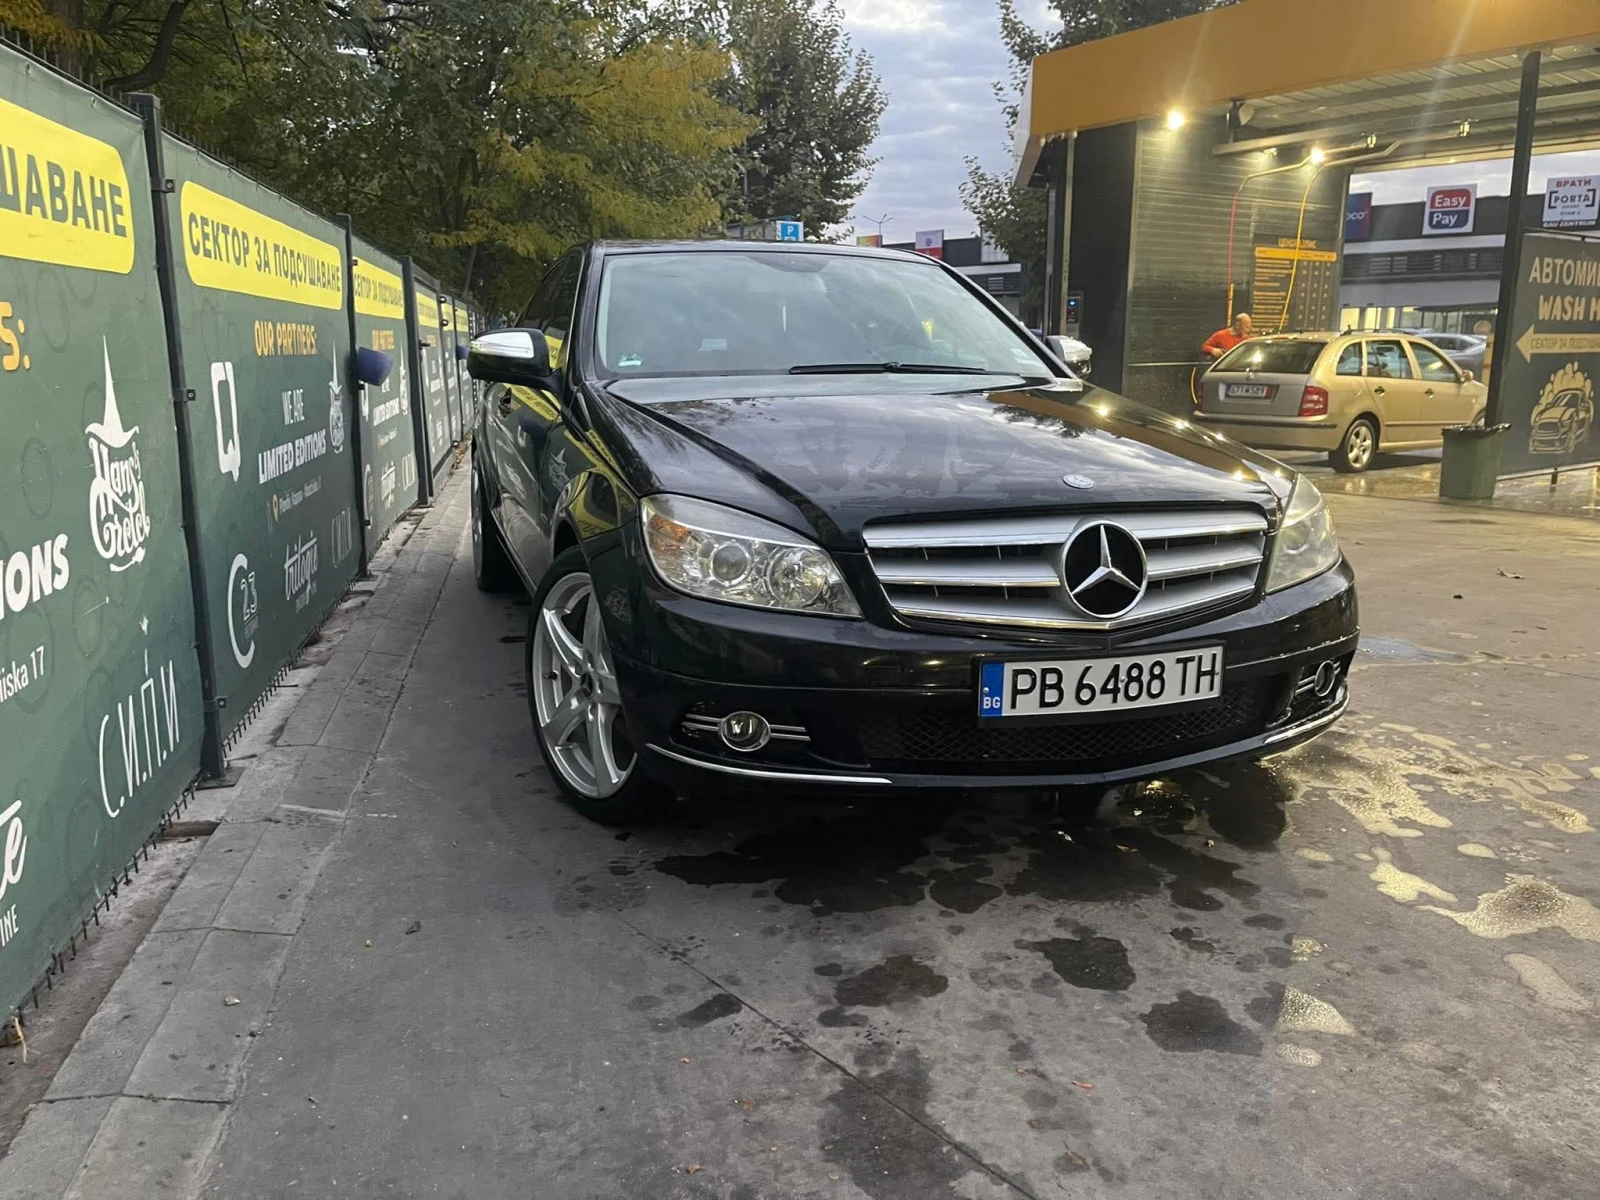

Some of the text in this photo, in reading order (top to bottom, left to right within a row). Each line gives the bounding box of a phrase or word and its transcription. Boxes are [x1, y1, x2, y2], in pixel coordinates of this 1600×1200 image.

[1555, 178, 1592, 188] ВРАТИ
[1434, 194, 1467, 208] Easy
[1554, 194, 1590, 204] PORTA
[787, 225, 794, 236] P
[1432, 212, 1458, 226] Pay
[188, 212, 341, 292] СЕКТОР ЗА ПОДСУШАВАНЕ
[1539, 294, 1585, 321] WASH
[254, 320, 275, 356] OUR
[282, 390, 293, 425] WE
[258, 428, 327, 485] LIMITED EDITIONS
[30, 645, 44, 680] 17
[1010, 652, 1217, 709] PB 6488 TH
[983, 697, 1001, 709] BG
